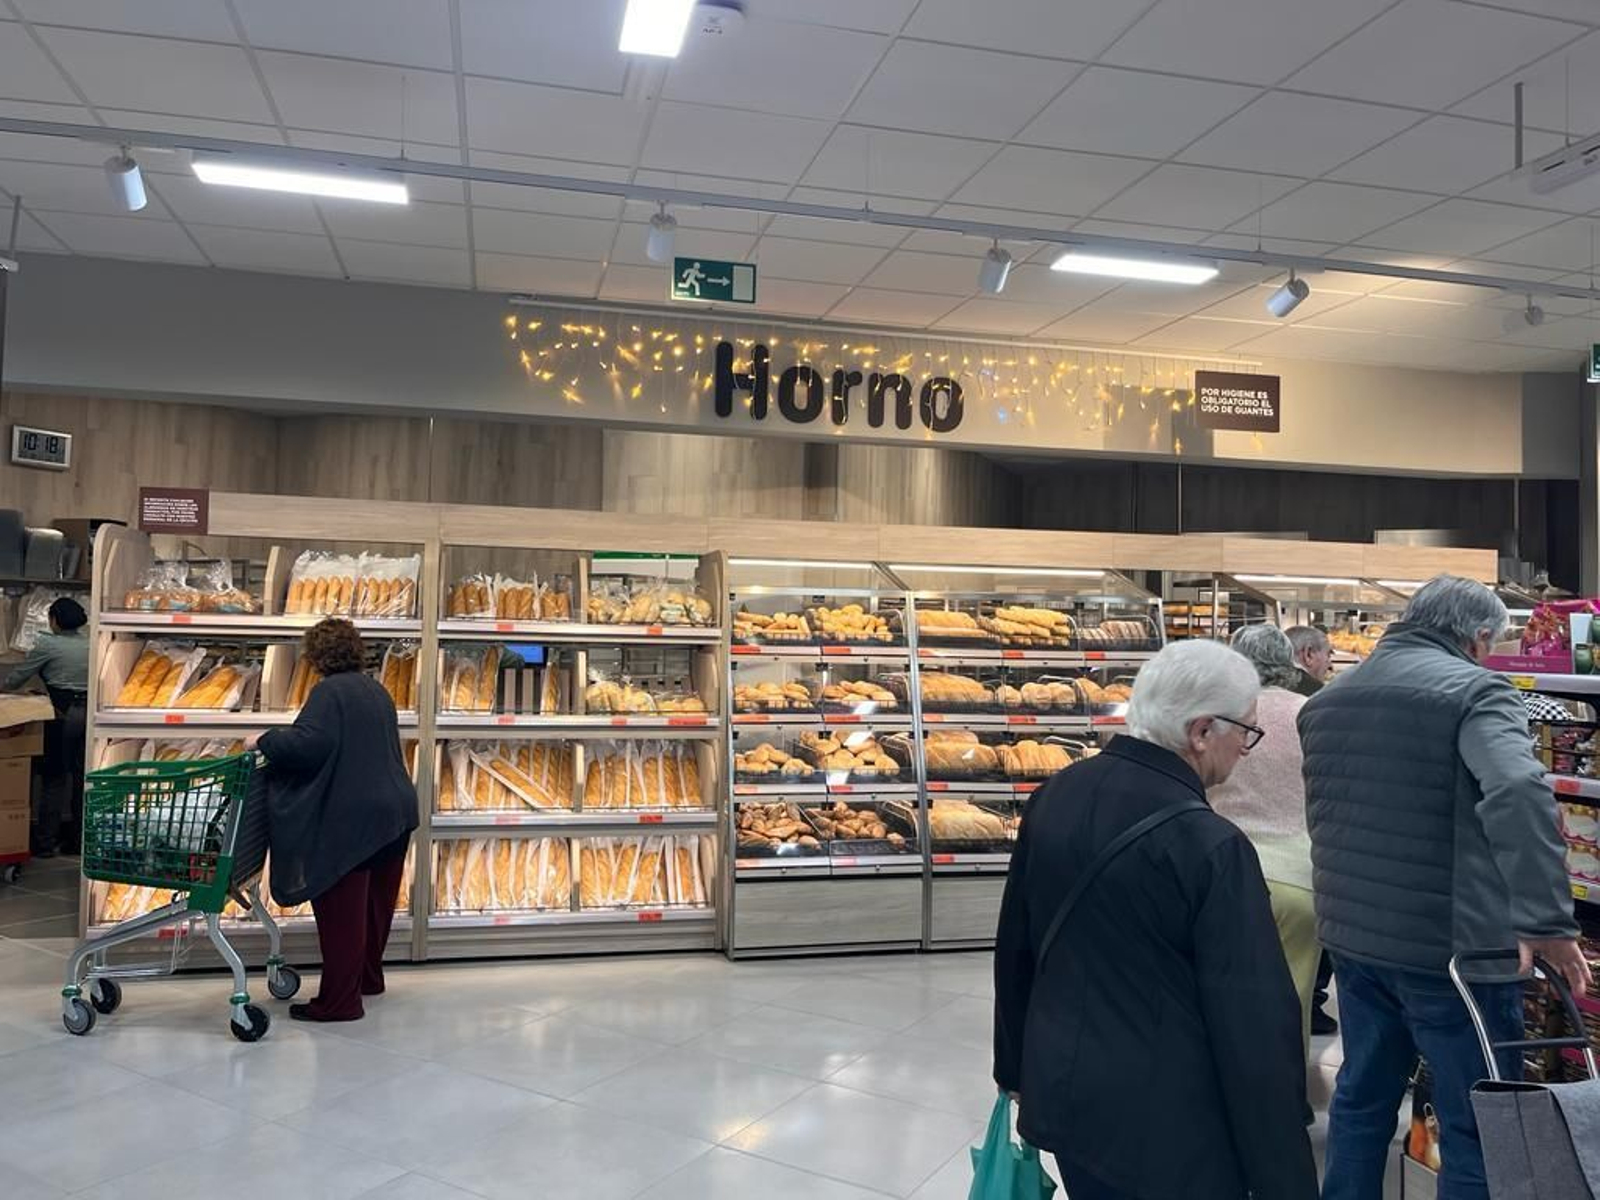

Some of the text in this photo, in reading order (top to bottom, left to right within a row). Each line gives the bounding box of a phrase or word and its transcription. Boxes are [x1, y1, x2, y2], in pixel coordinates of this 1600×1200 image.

[715, 341, 964, 433] Horno
[1201, 388, 1268, 399] POR HIGIENE ES
[1201, 396, 1272, 408] OBLIGATORIO EL
[1201, 405, 1220, 413] USO
[1234, 407, 1274, 416] GUANTES
